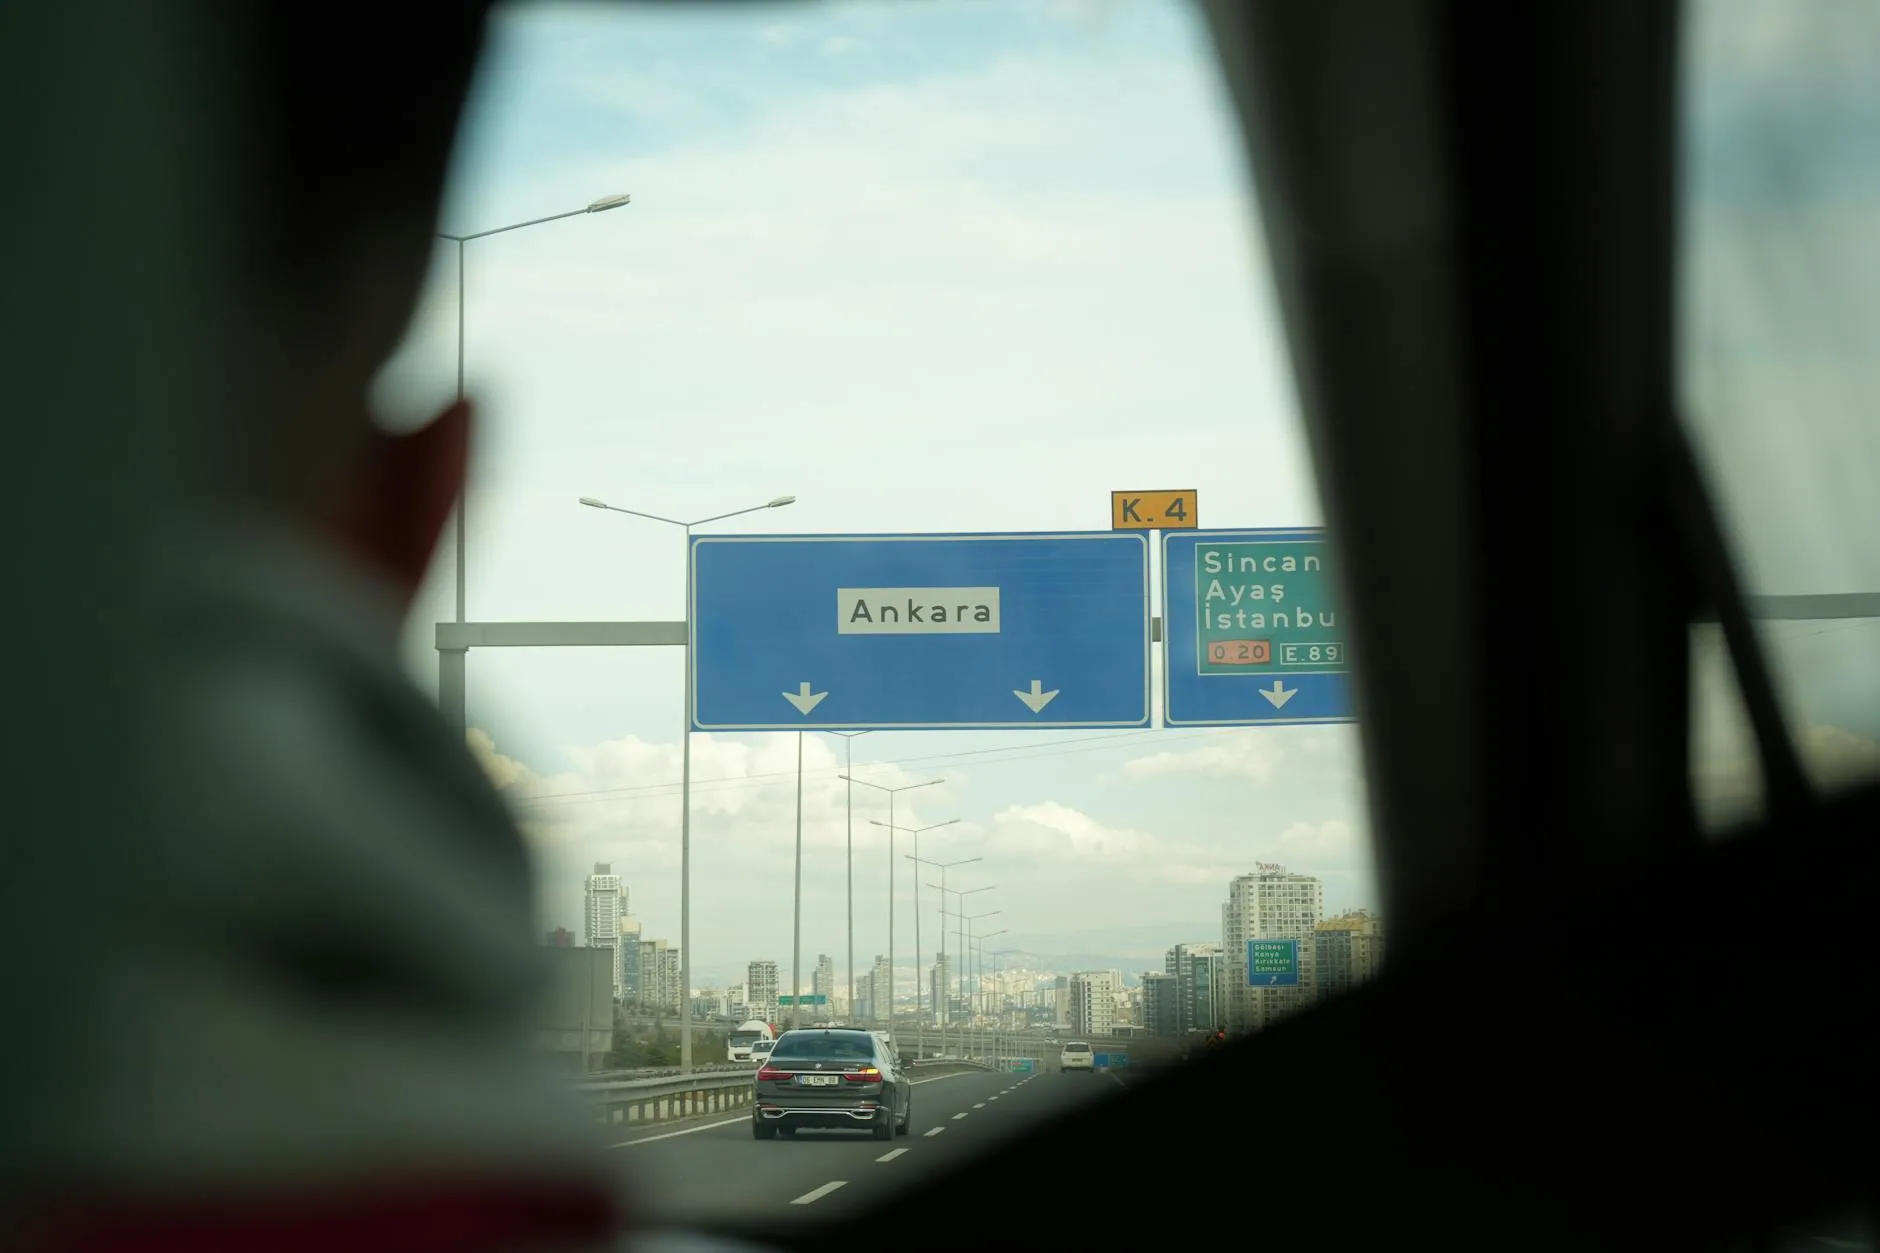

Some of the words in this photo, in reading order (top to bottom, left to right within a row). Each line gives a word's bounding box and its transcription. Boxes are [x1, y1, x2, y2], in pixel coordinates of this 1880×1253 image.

[1204, 551, 1321, 573] Sincan
[1204, 579, 1286, 606] Ayaş
[850, 598, 991, 624] Ankara
[1204, 602, 1336, 630] İstanbu
[1285, 646, 1339, 662] E.89
